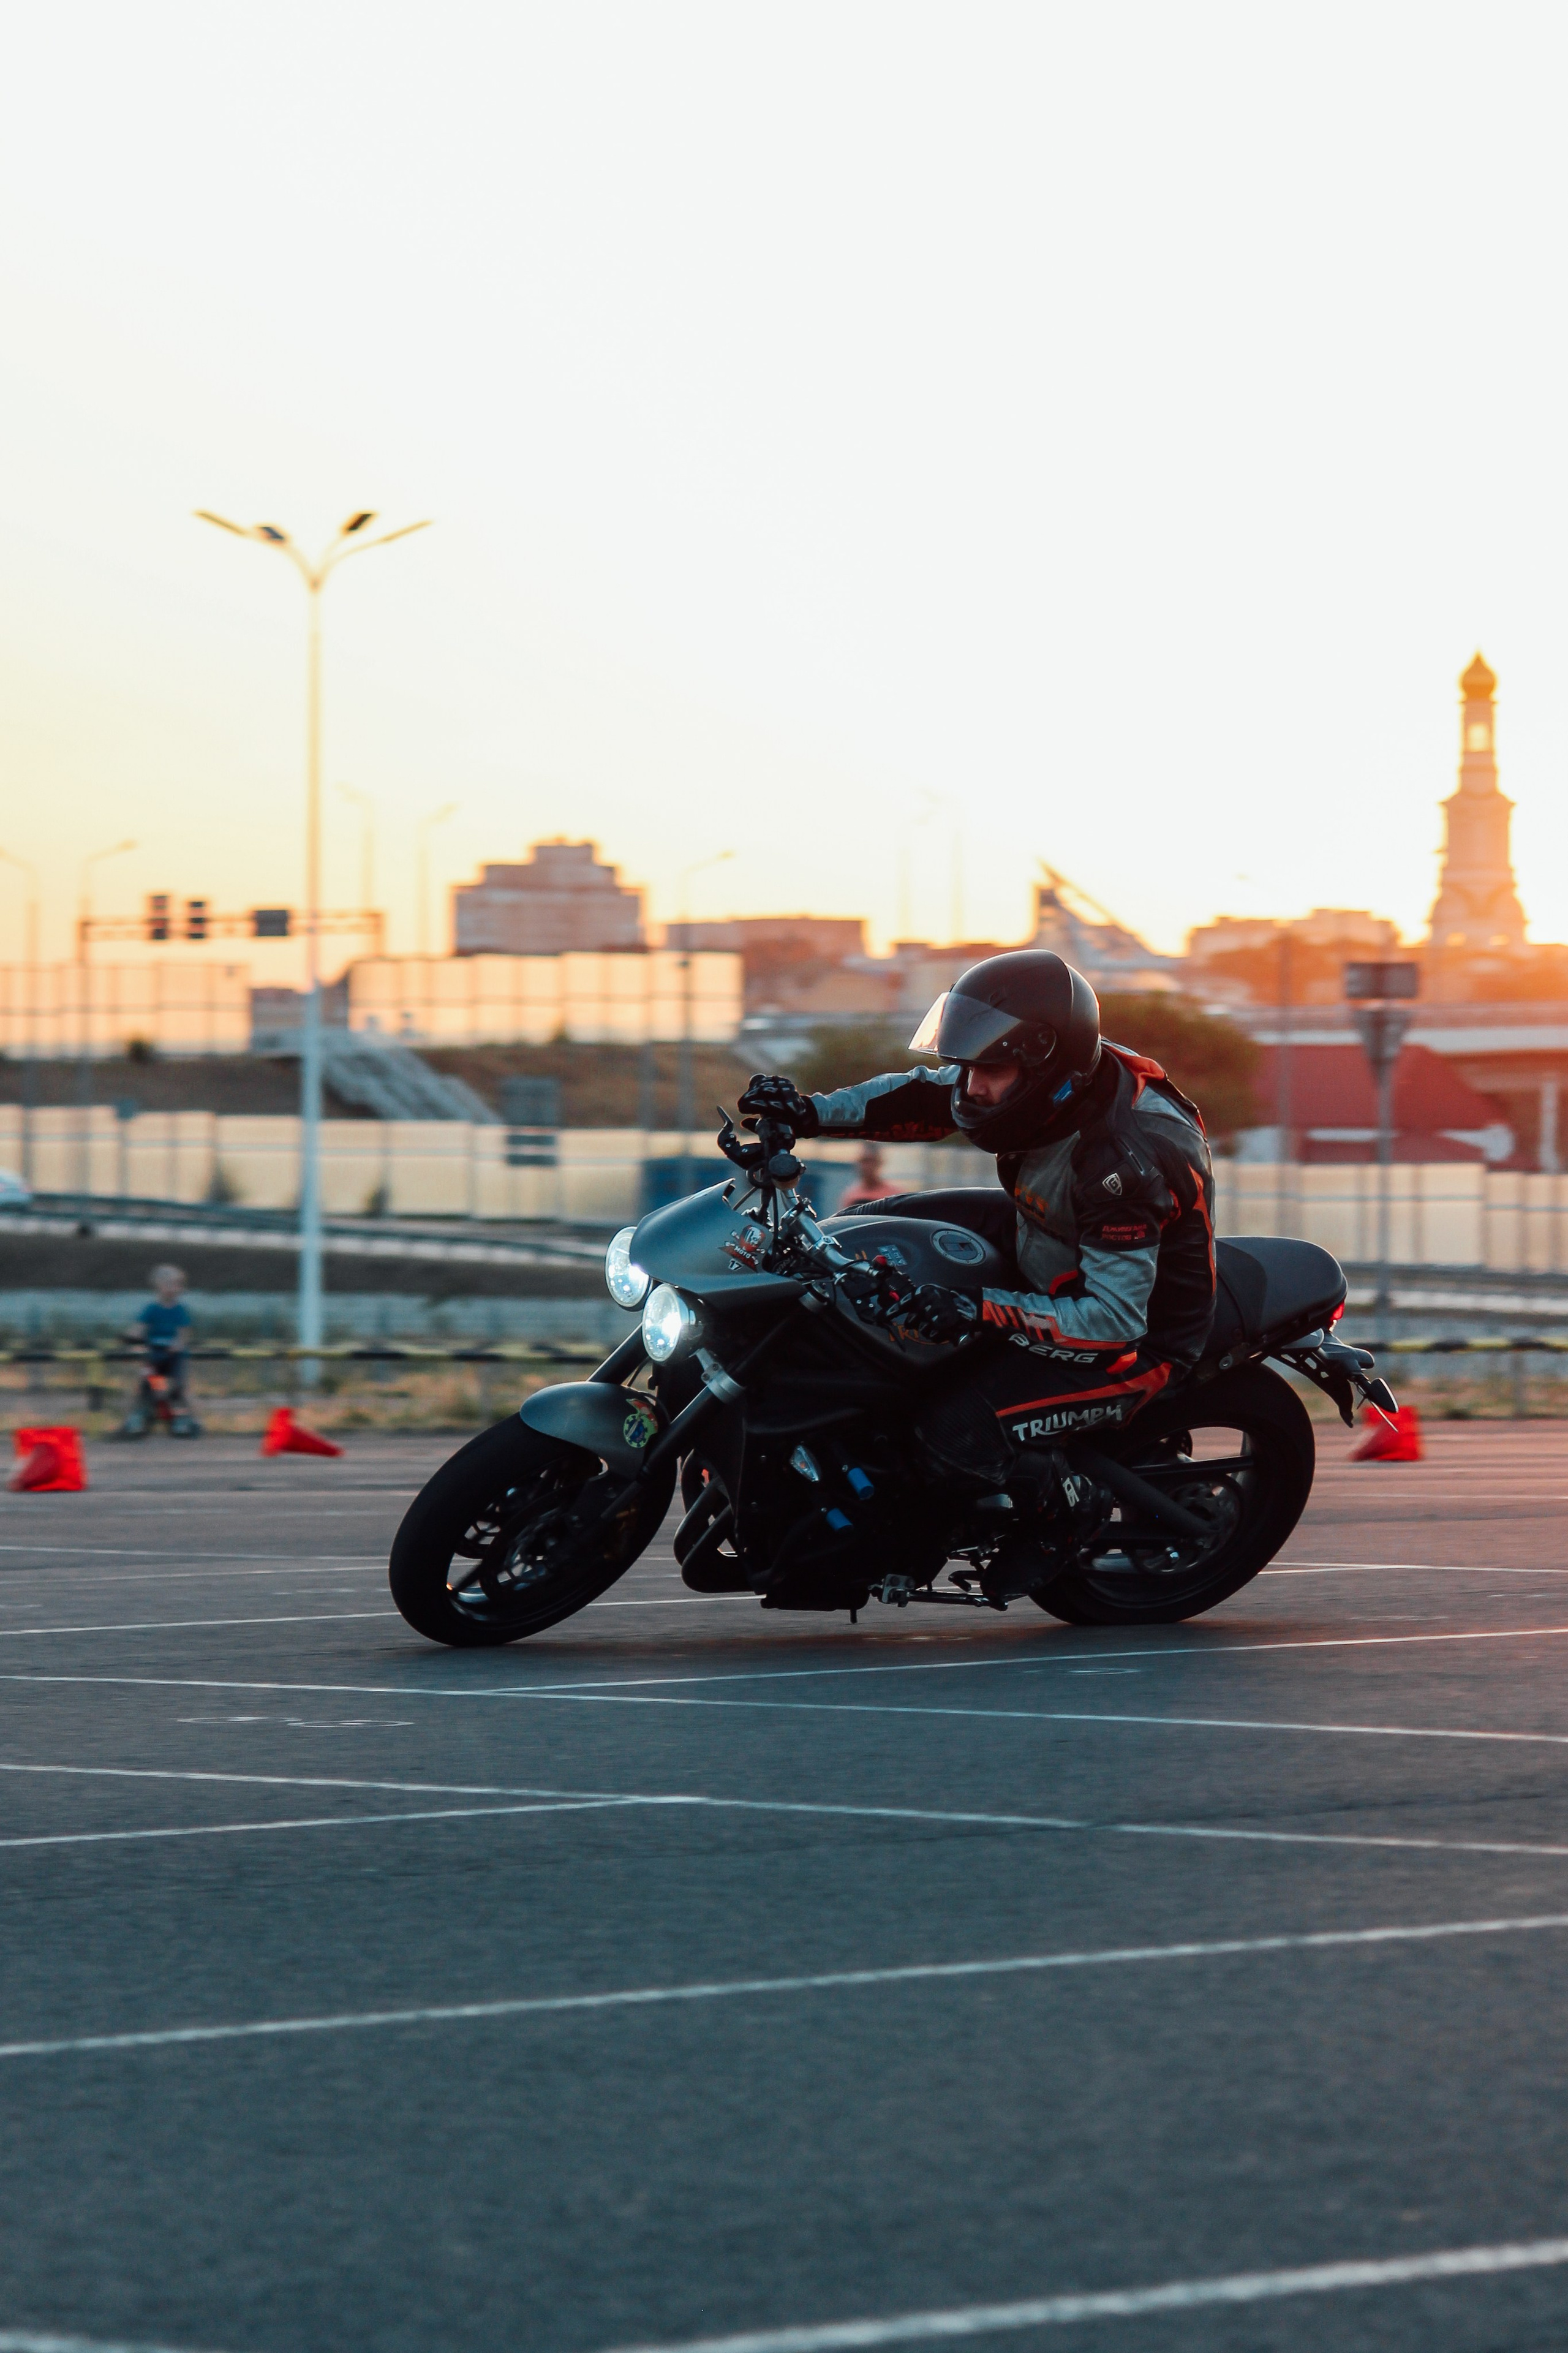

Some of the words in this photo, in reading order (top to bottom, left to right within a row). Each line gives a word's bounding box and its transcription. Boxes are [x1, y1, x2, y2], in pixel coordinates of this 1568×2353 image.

[734, 1245, 752, 1259] MOTO
[728, 1259, 742, 1271] 17
[1012, 1404, 1122, 1441] TRIUMPH
